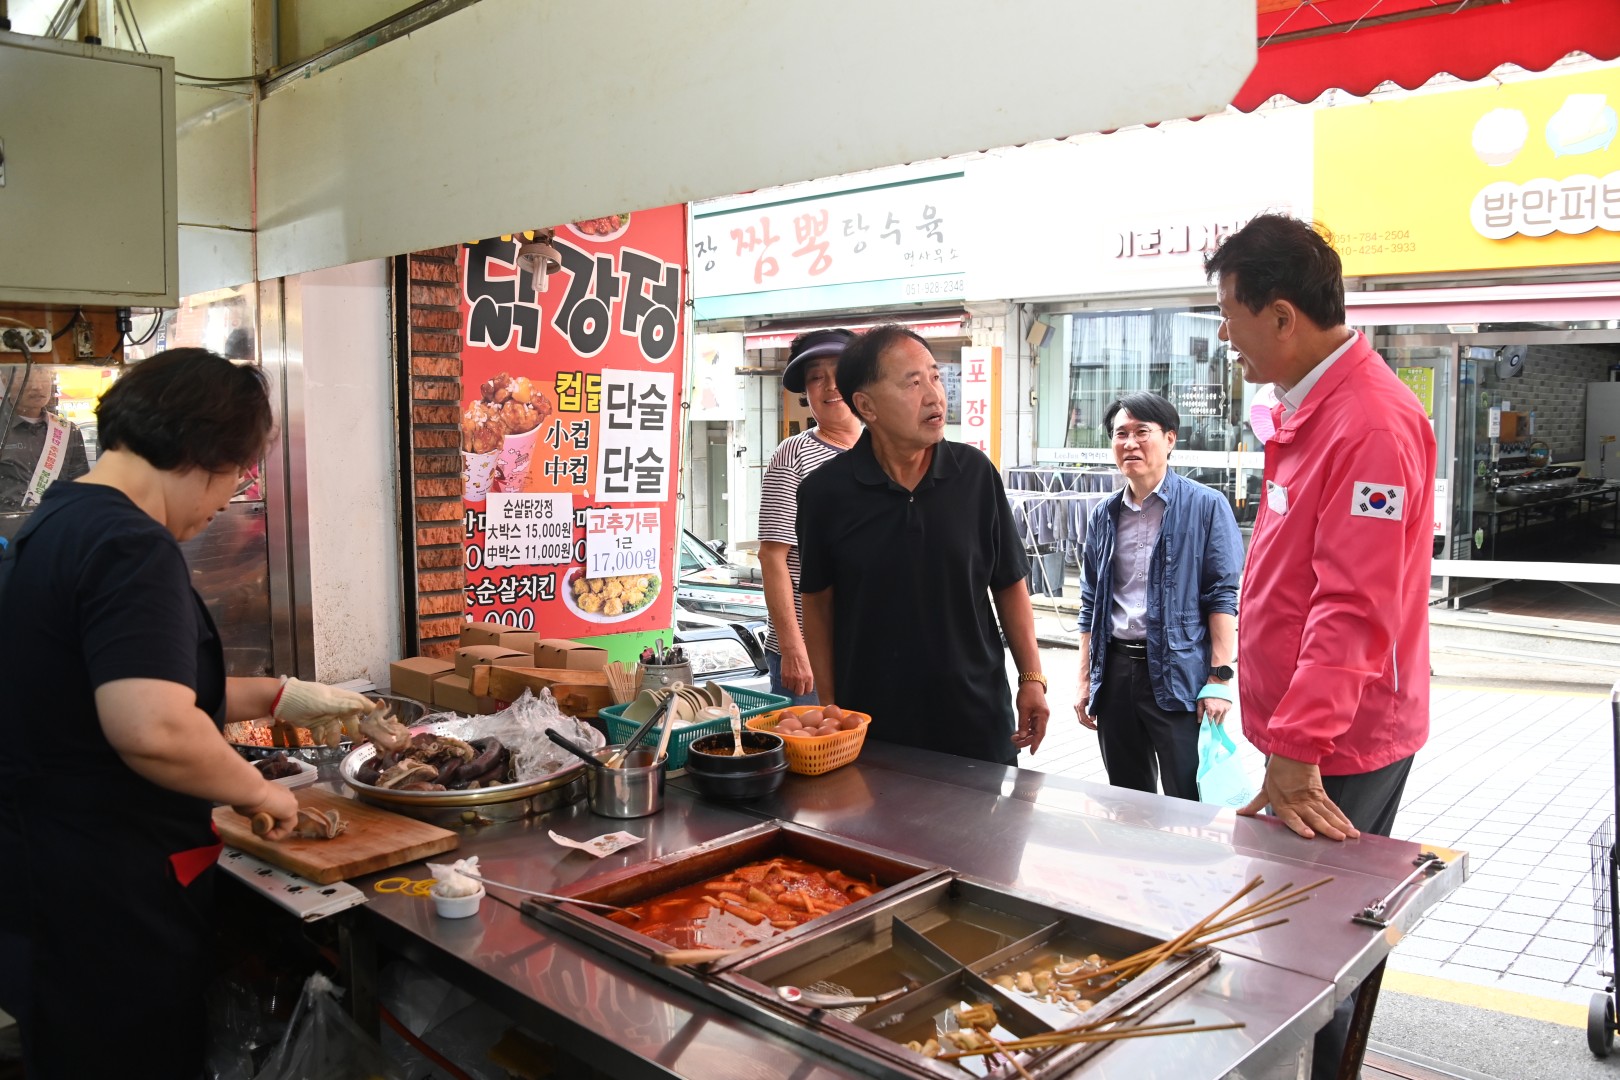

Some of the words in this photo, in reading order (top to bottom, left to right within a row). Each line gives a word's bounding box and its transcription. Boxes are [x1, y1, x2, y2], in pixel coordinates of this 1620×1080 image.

[730, 208, 833, 285] 짬뽕
[842, 204, 944, 254] 탕수육
[466, 236, 681, 360] 닭강정
[606, 382, 668, 431] 단술
[544, 419, 590, 450] 小컵
[544, 454, 589, 486] 中컵
[603, 446, 665, 494] 단술
[503, 499, 553, 519] 순살닭강정
[588, 511, 659, 536] 고추가루
[487, 523, 521, 541] 大박스
[526, 522, 571, 540] 15,000원
[615, 536, 633, 549] 1근
[487, 544, 521, 562] 中박스
[525, 542, 571, 561] 11,000원
[592, 547, 657, 574] 17,000원
